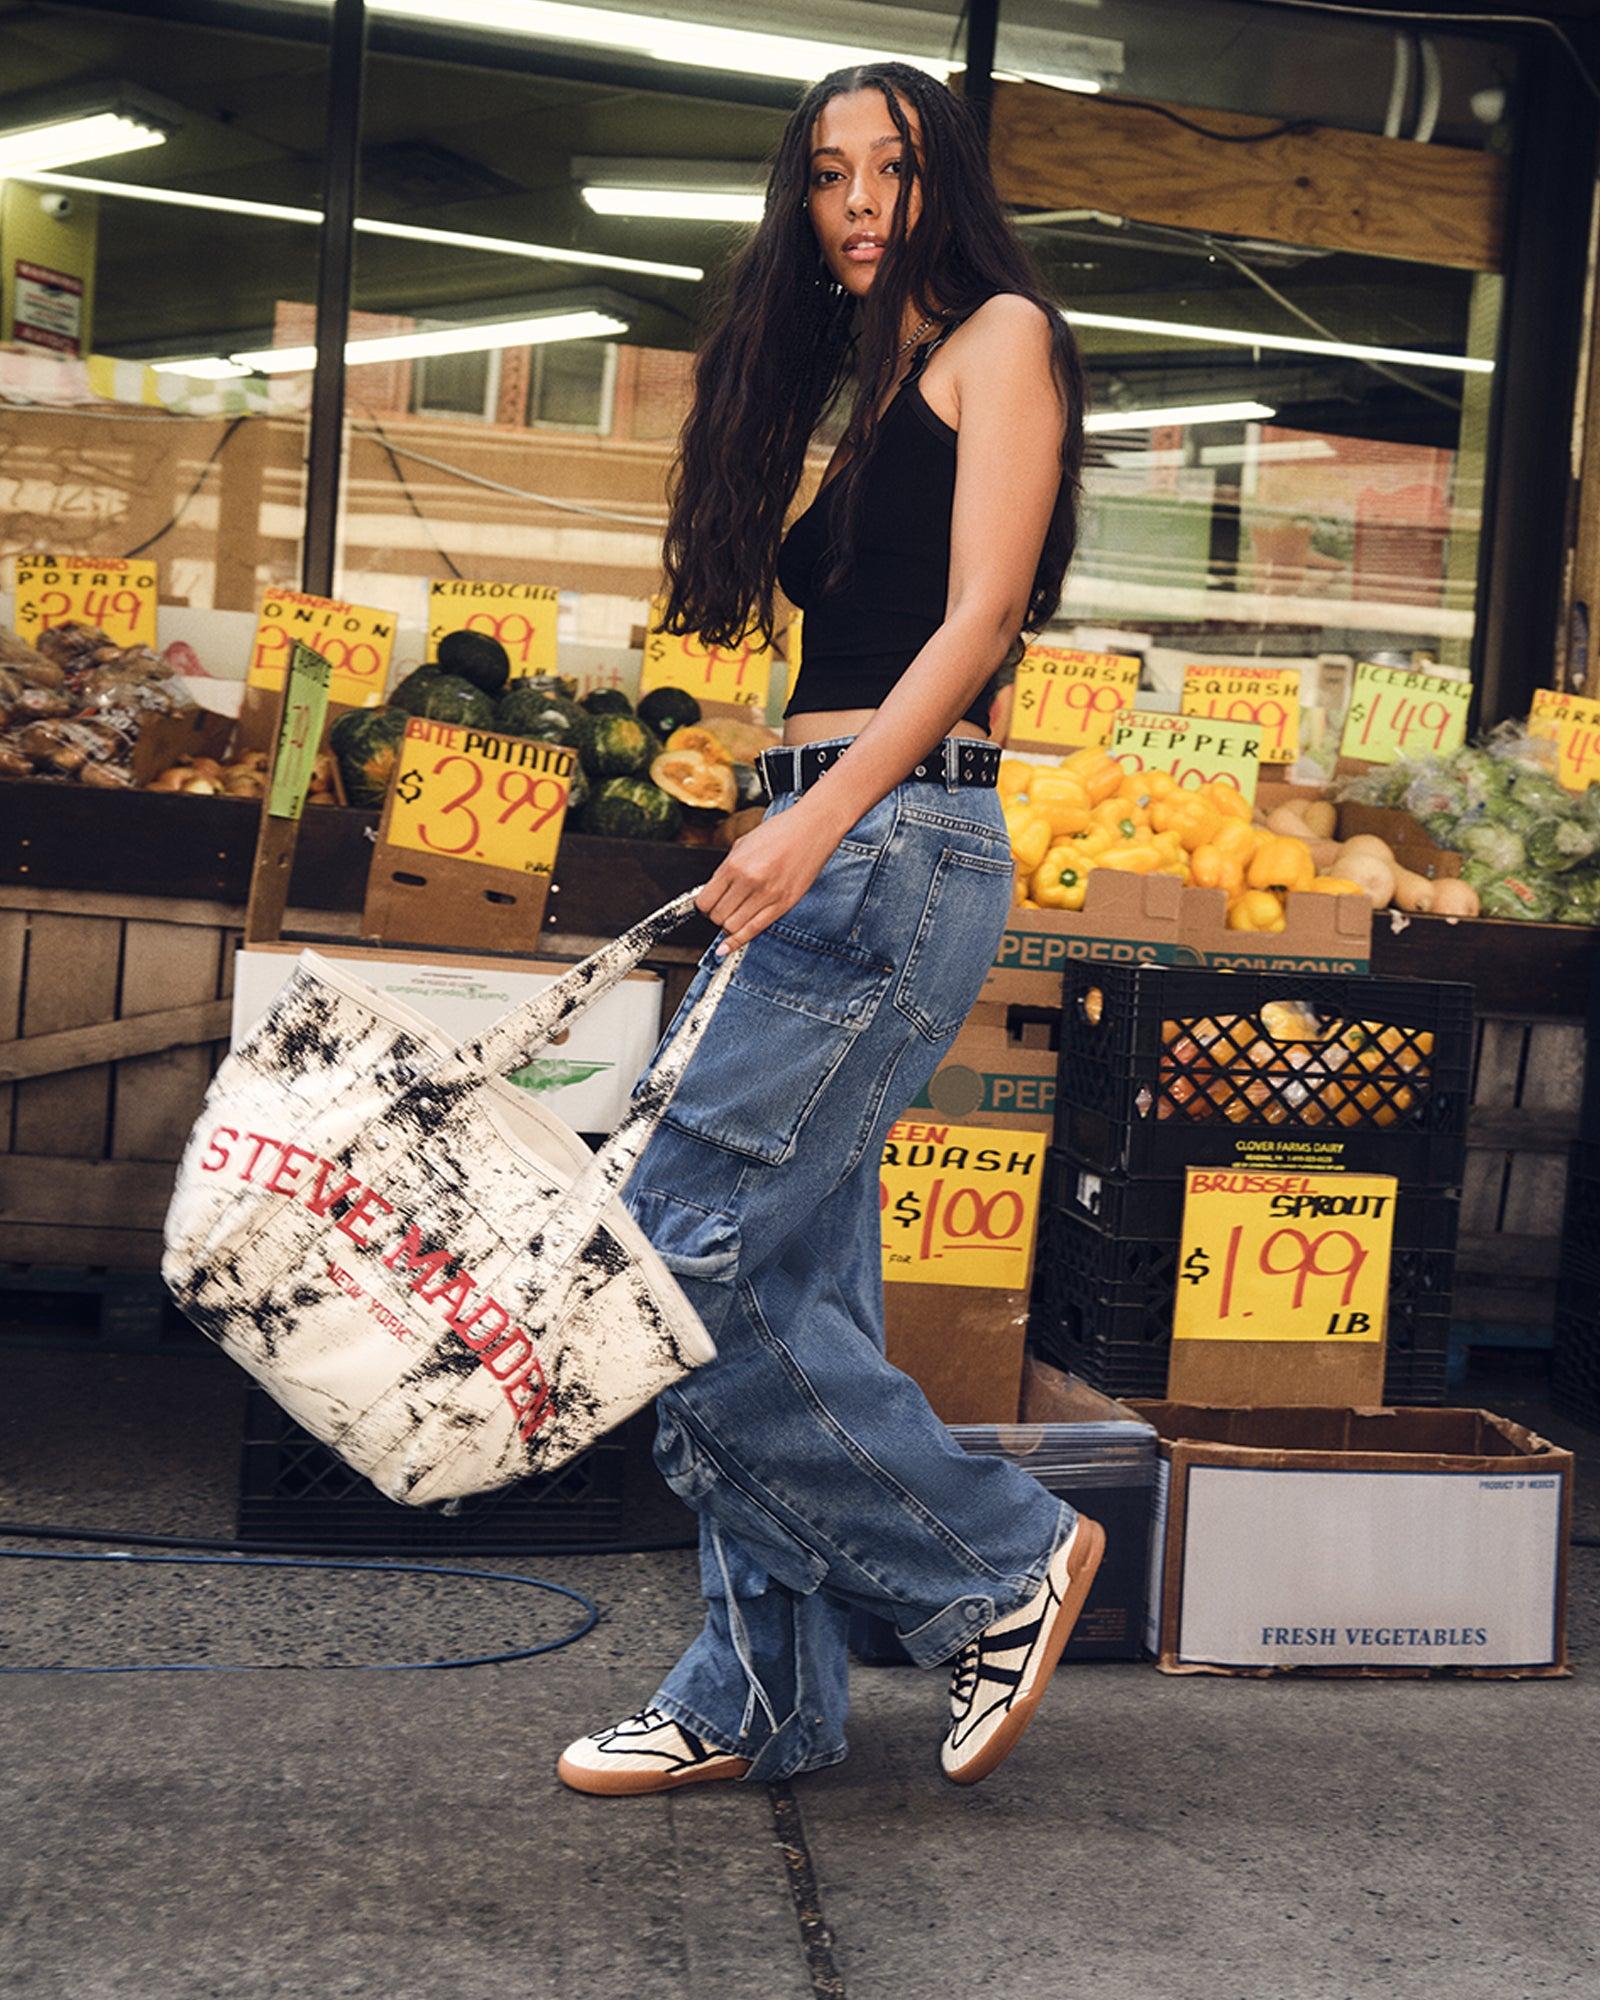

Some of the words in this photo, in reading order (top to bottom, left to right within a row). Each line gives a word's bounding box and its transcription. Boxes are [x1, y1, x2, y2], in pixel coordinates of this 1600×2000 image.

[18, 572, 154, 588] POTATO
[431, 582, 557, 601] KABOCHA
[264, 602, 391, 638] ONION
[1018, 659, 1138, 684] SQUASH
[1182, 679, 1299, 697] SQUASH
[1117, 711, 1190, 733] YELLOW
[1115, 727, 1260, 758] PEPPER
[463, 732, 576, 777] POTATO
[1235, 1141, 1275, 1152] CLOVER
[1277, 1142, 1312, 1153] FARMS
[1190, 1174, 1318, 1195] BRUSSEL
[1269, 1194, 1391, 1219] SPROUT
[200, 1125, 394, 1248] STEVE
[382, 1224, 557, 1443] MADDEN
[327, 1260, 368, 1300] NEW
[367, 1299, 414, 1342] YORK
[1325, 1312, 1371, 1335] LB
[1261, 1627, 1336, 1646] FRESH
[1345, 1627, 1488, 1646] VEGETABLES
